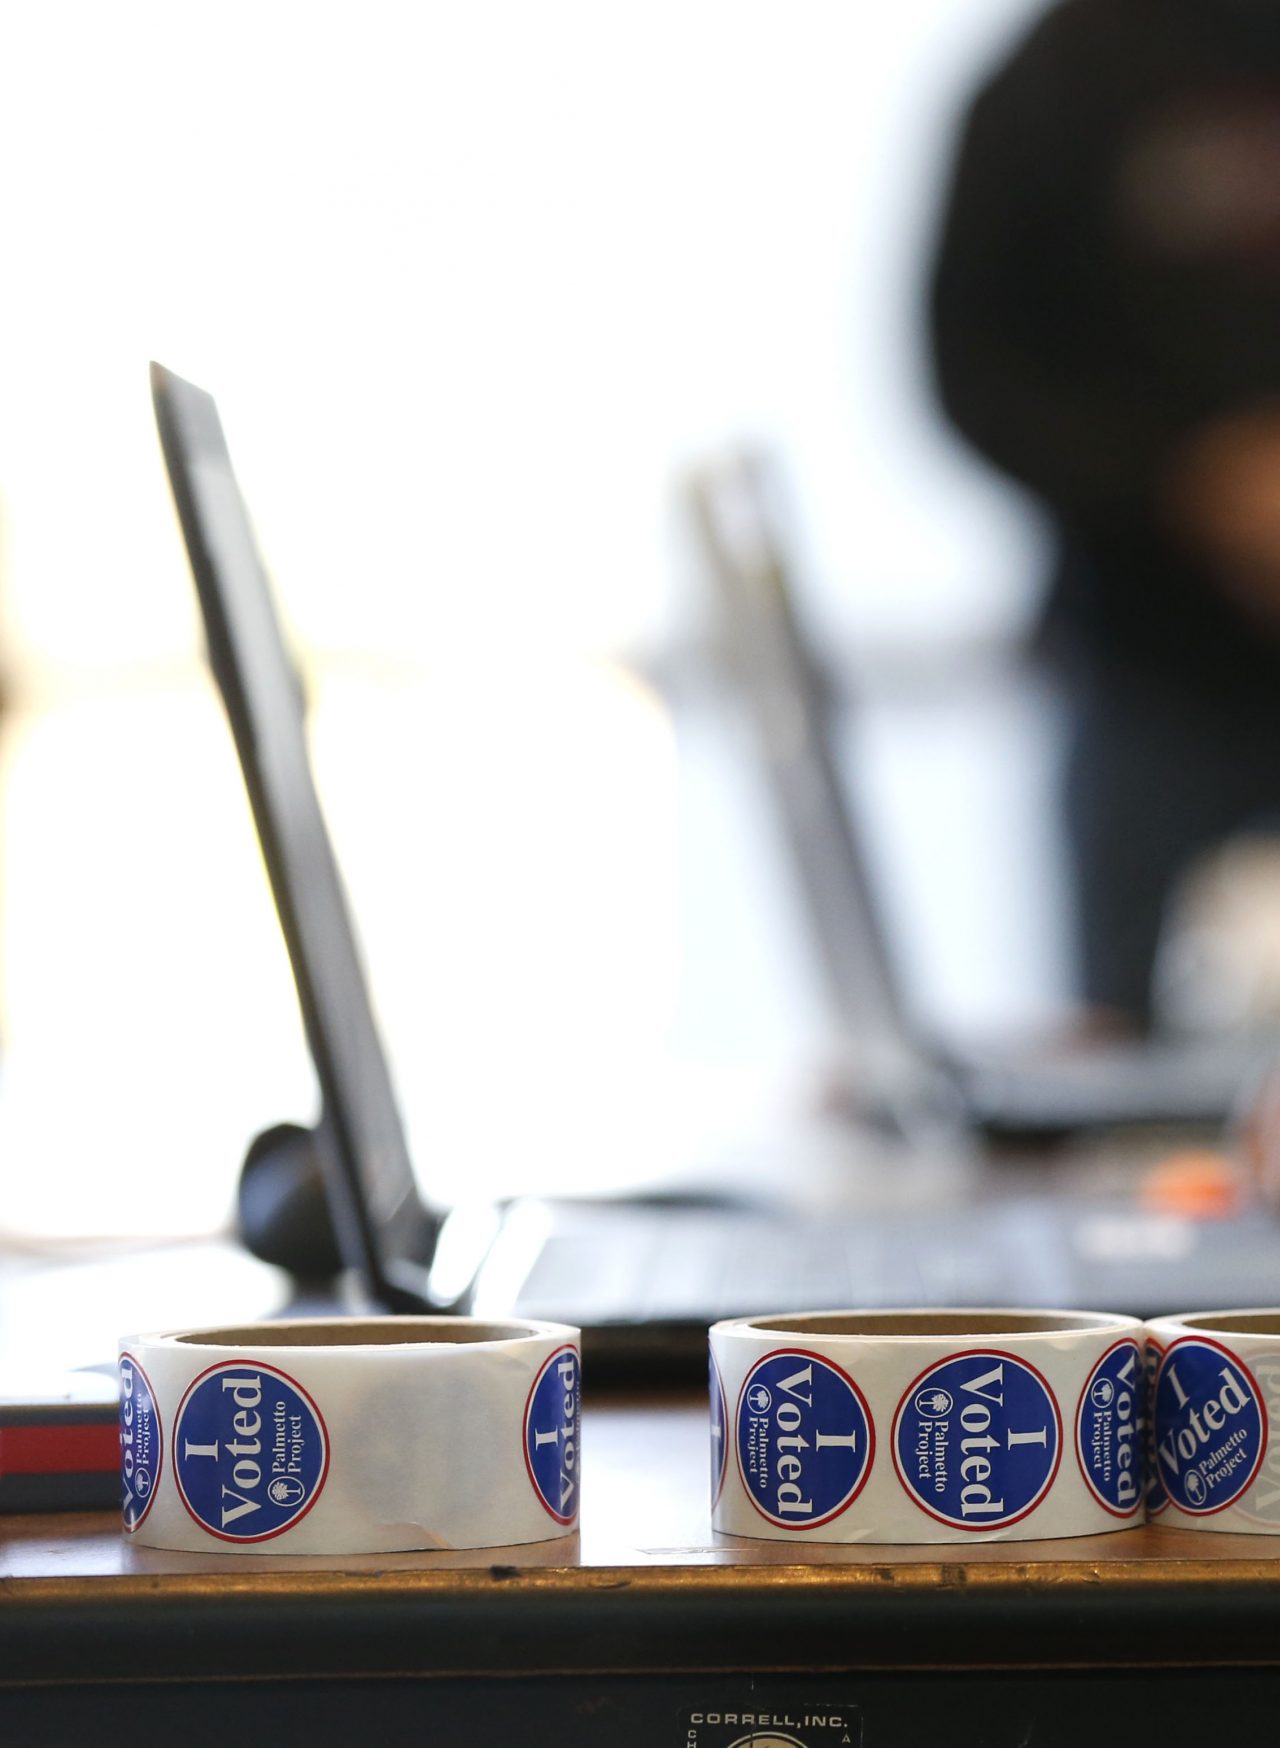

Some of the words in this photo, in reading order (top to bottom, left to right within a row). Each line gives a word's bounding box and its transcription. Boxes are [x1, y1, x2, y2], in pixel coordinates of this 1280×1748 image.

[1167, 1363, 1191, 1410] I
[120, 1367, 134, 1511] Voted
[185, 1438, 219, 1462] I
[222, 1375, 263, 1528] Voted
[272, 1401, 287, 1474] Palmetto
[288, 1415, 305, 1473] Project
[535, 1427, 559, 1451] I
[558, 1359, 575, 1512] Voted
[747, 1417, 759, 1473] Project
[758, 1417, 770, 1489] Palmetto
[775, 1363, 814, 1515] Voted
[815, 1429, 856, 1453] I
[915, 1421, 933, 1479] Project
[959, 1363, 1004, 1517] Voted
[1007, 1425, 1047, 1451] I
[1091, 1411, 1103, 1469] Project
[1103, 1410, 1112, 1482] Palmetto
[1116, 1352, 1137, 1504] Voted
[1159, 1367, 1251, 1476] Voted
[1198, 1427, 1248, 1476] Palmetto
[934, 1421, 949, 1493] Palmetto
[1205, 1447, 1248, 1490] Project
